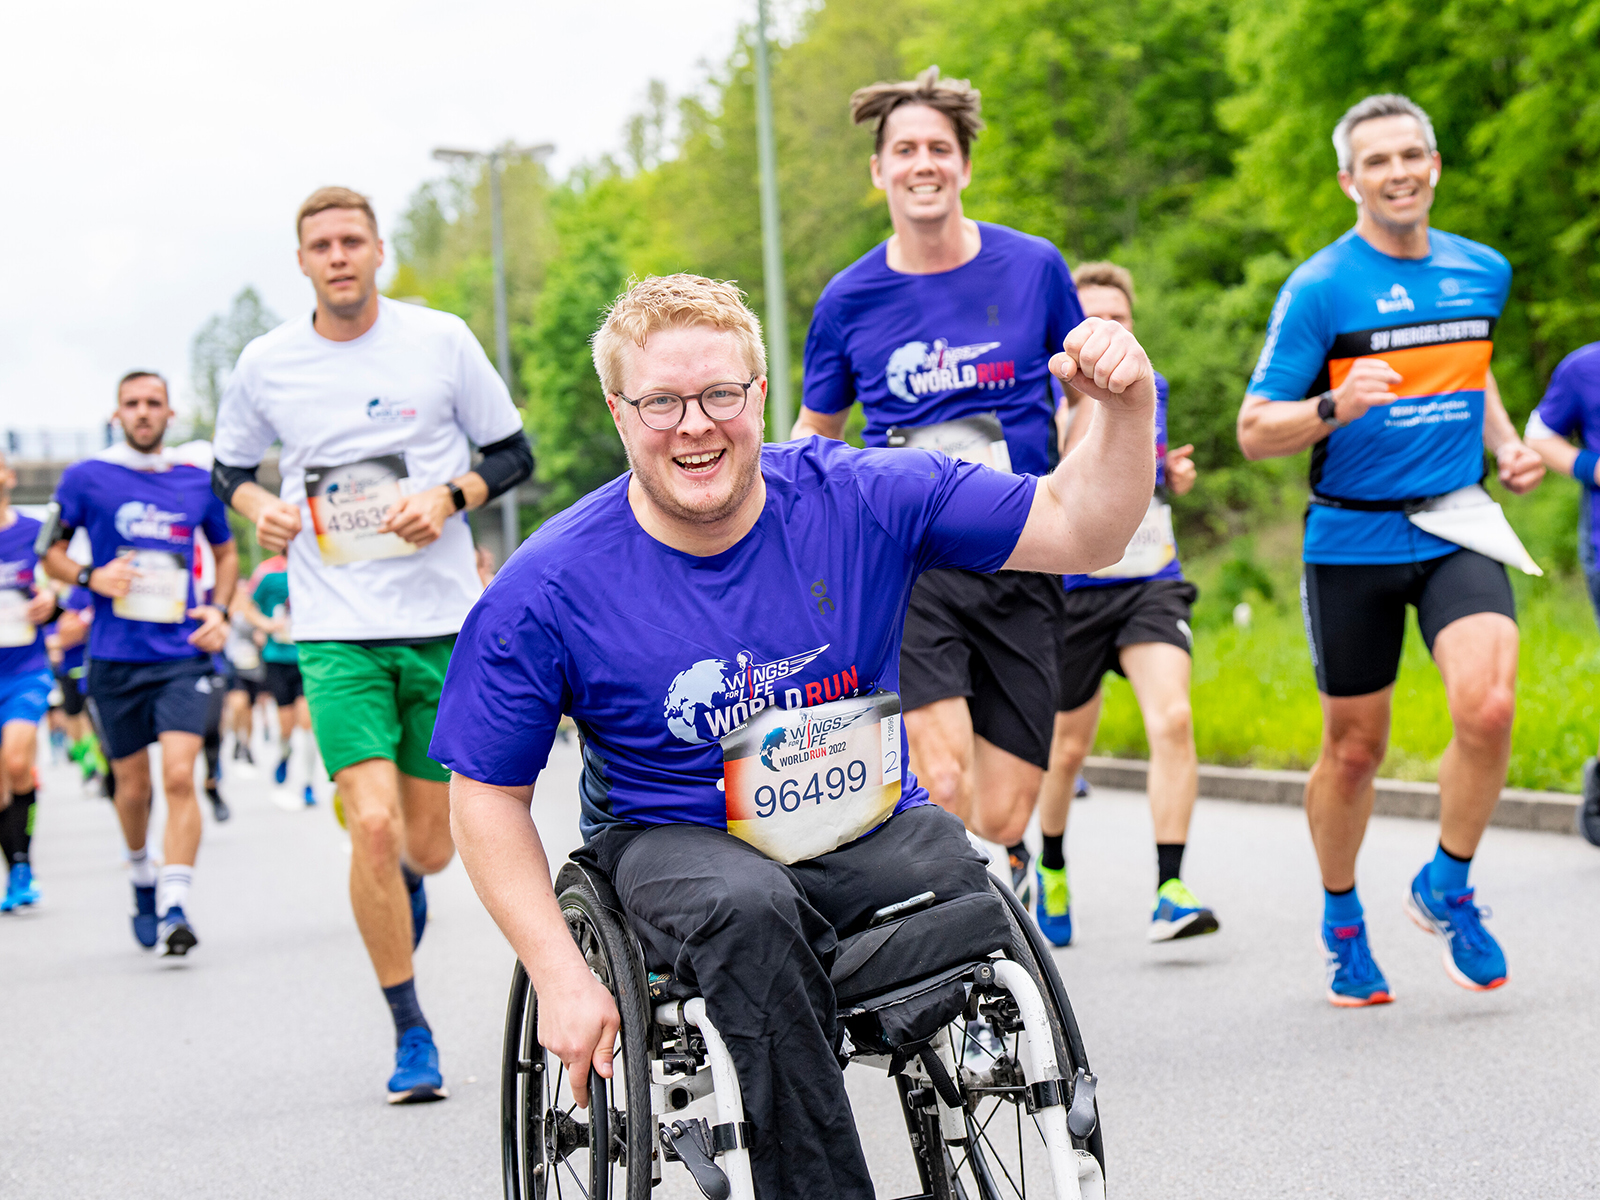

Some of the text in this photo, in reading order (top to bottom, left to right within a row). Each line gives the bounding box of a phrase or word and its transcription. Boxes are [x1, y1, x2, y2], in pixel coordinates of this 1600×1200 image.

[725, 689, 739, 700] FOR
[788, 739, 800, 748] FOR
[828, 741, 847, 755] 2022
[884, 750, 898, 774] 2
[754, 760, 867, 818] 96499
